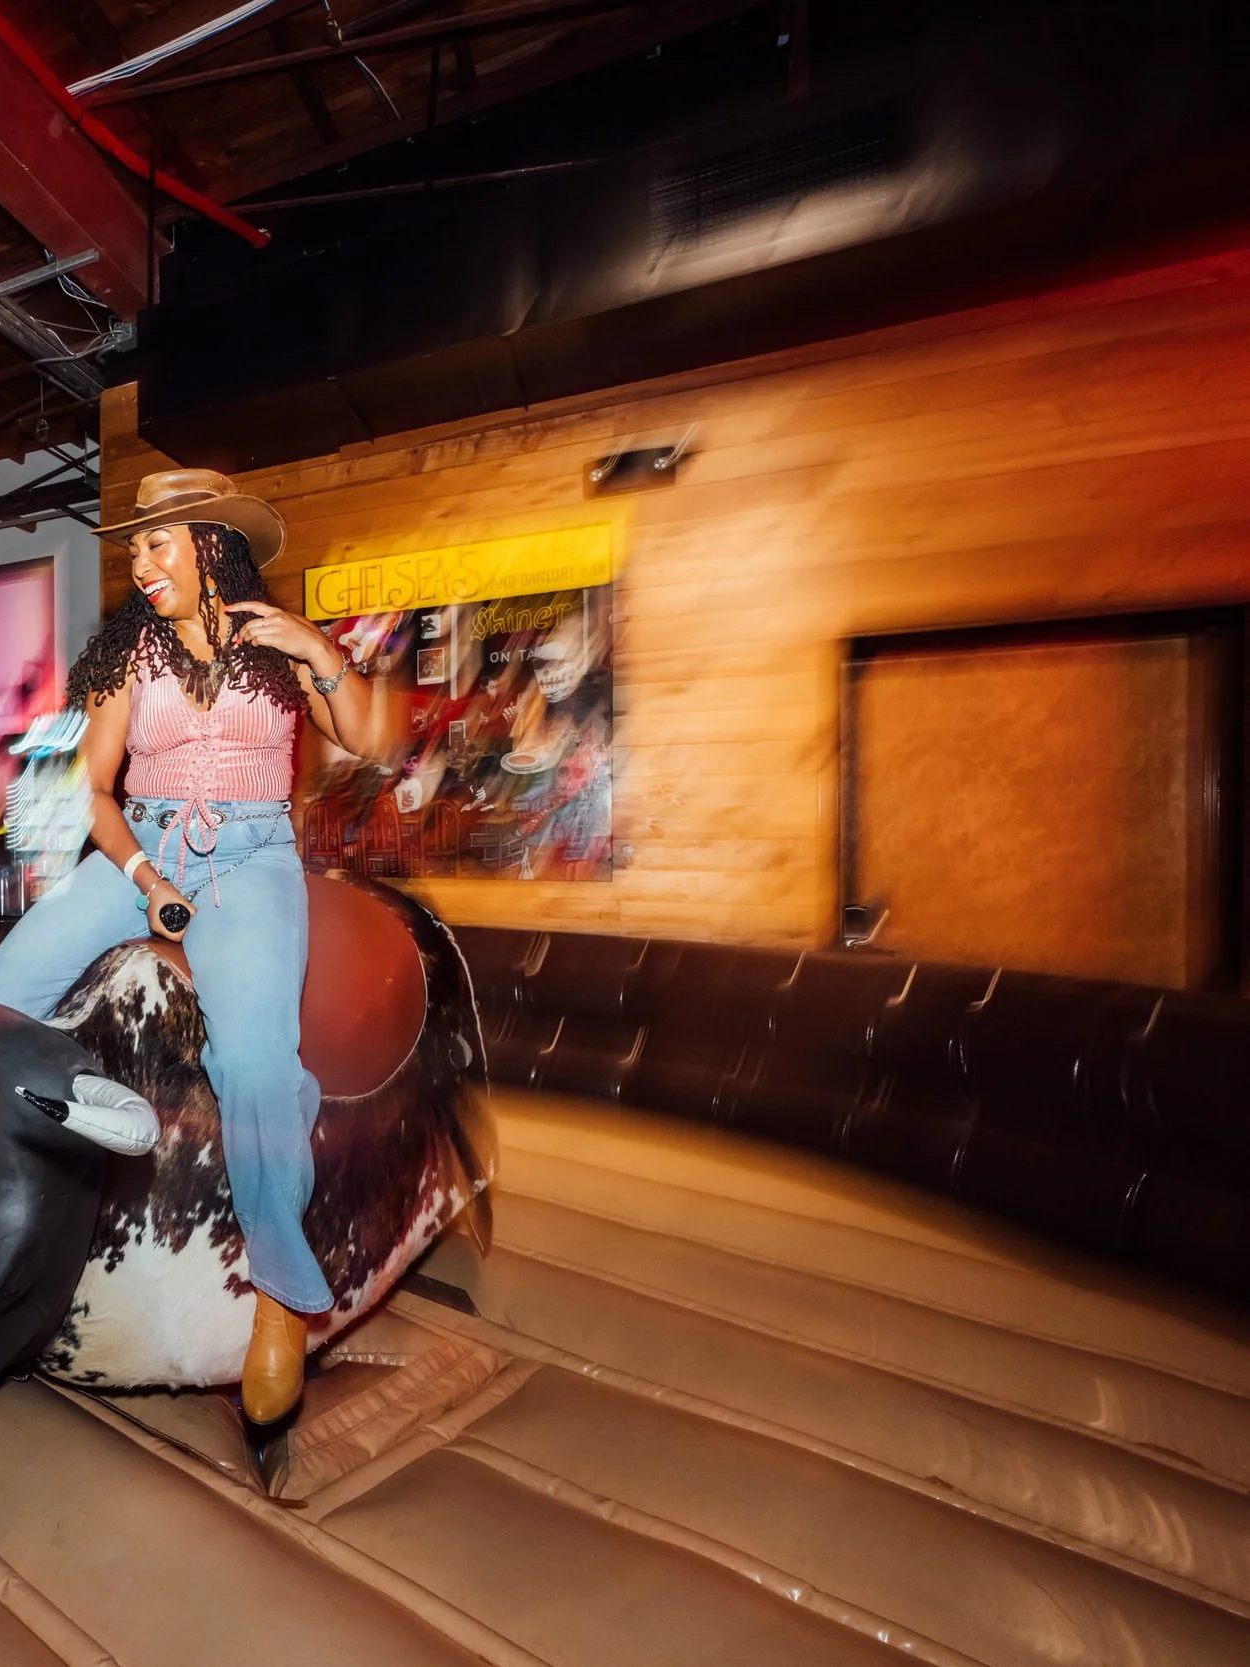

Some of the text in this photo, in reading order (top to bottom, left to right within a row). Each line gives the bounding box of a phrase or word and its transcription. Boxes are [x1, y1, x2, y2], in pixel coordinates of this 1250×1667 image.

[581, 561, 607, 578] BAR
[470, 602, 573, 641] Shiner
[490, 649, 537, 663] ON TA
